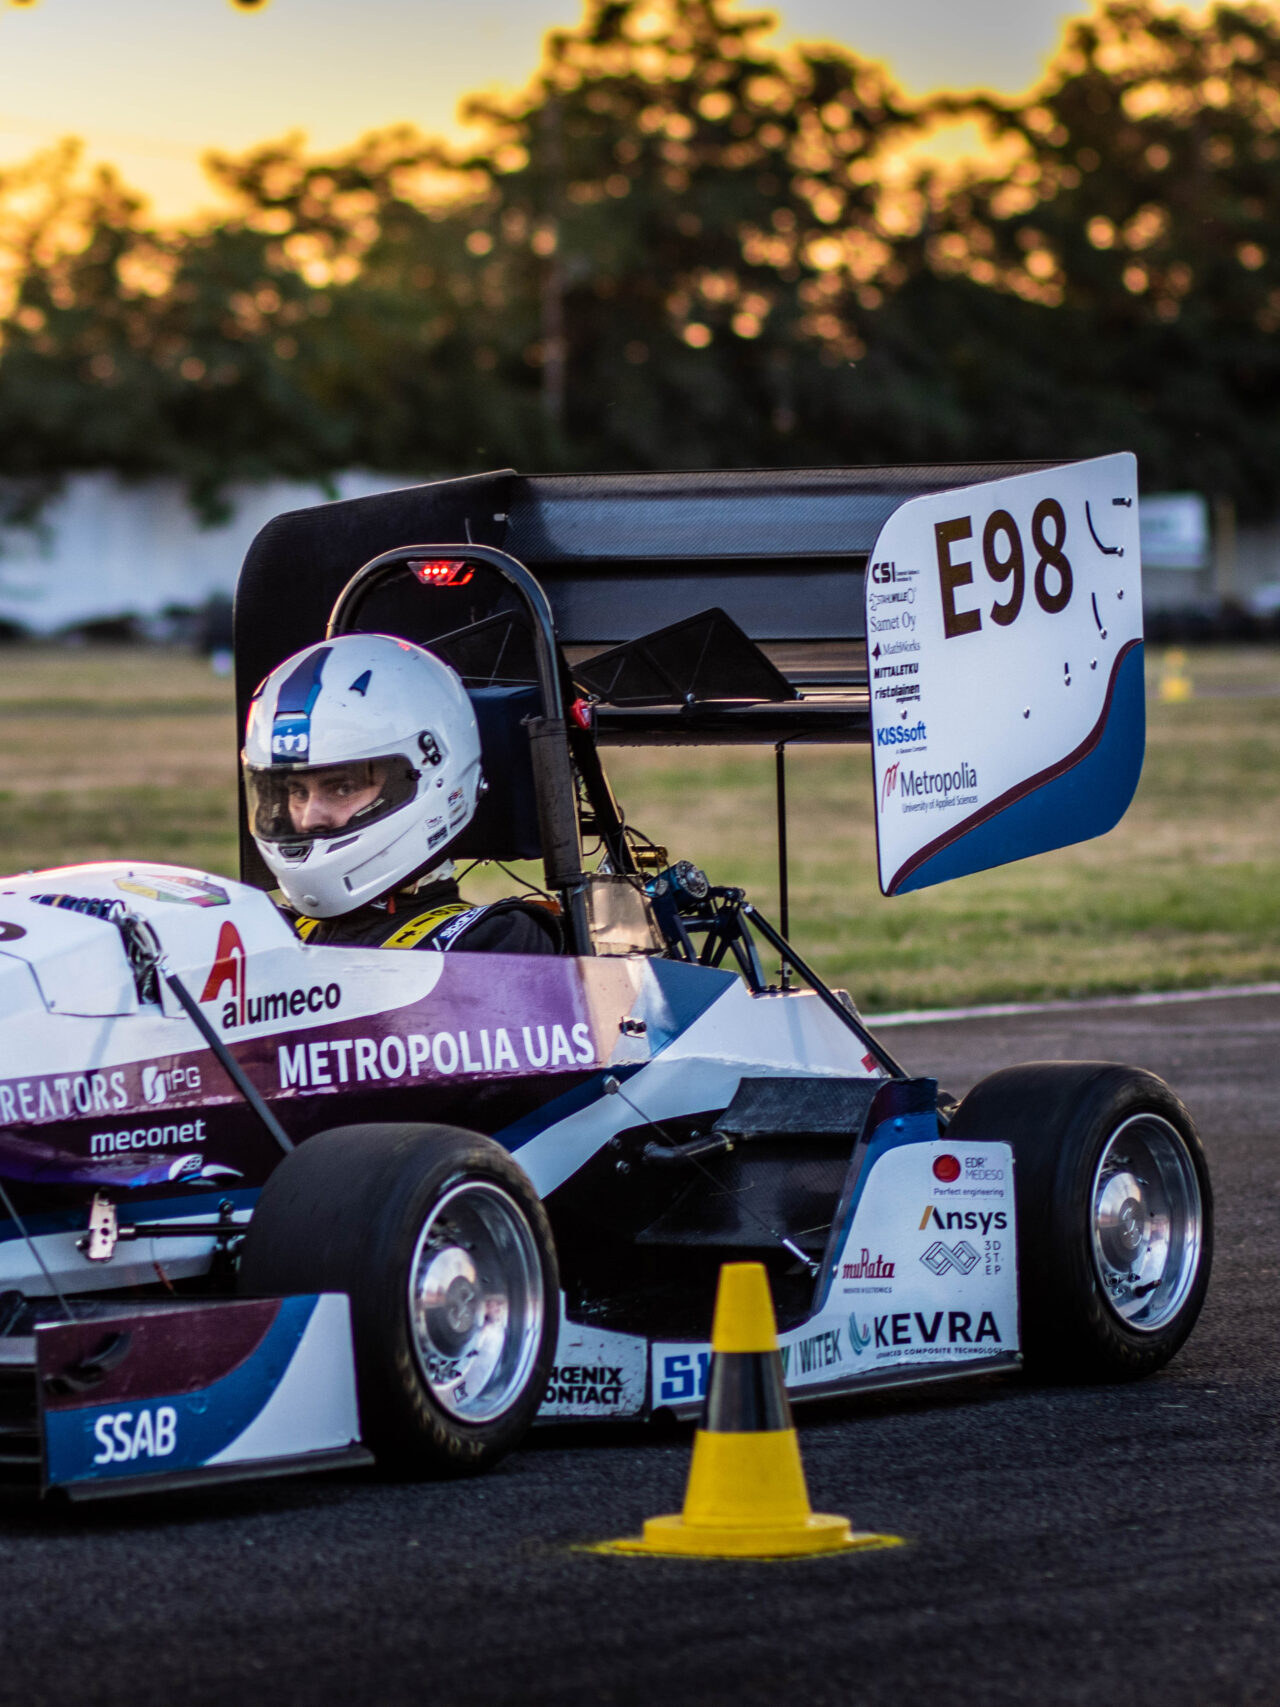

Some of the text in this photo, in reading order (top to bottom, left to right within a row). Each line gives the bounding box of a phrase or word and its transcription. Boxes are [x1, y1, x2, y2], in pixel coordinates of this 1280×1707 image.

[872, 562, 895, 584] CSI
[934, 498, 1074, 640] E98
[870, 611, 917, 633] Samet Oy
[876, 720, 927, 747] KISSsoft
[900, 761, 978, 798] Metropolia
[902, 802, 928, 814] University
[936, 797, 956, 811] Applied
[956, 794, 979, 806] Sciences
[278, 1022, 595, 1090] METROPOLIA UAS
[91, 1118, 207, 1154] meconet
[965, 1169, 1004, 1181] MEDESO
[933, 1187, 1005, 1198] Perfect engineering
[918, 1204, 1008, 1236] Ansys
[842, 1248, 896, 1279] muRata
[873, 1311, 1003, 1349] KEVRA
[799, 1328, 843, 1375] WITEK
[544, 1385, 624, 1405] ONTACT
[94, 1406, 177, 1464] SSAB
